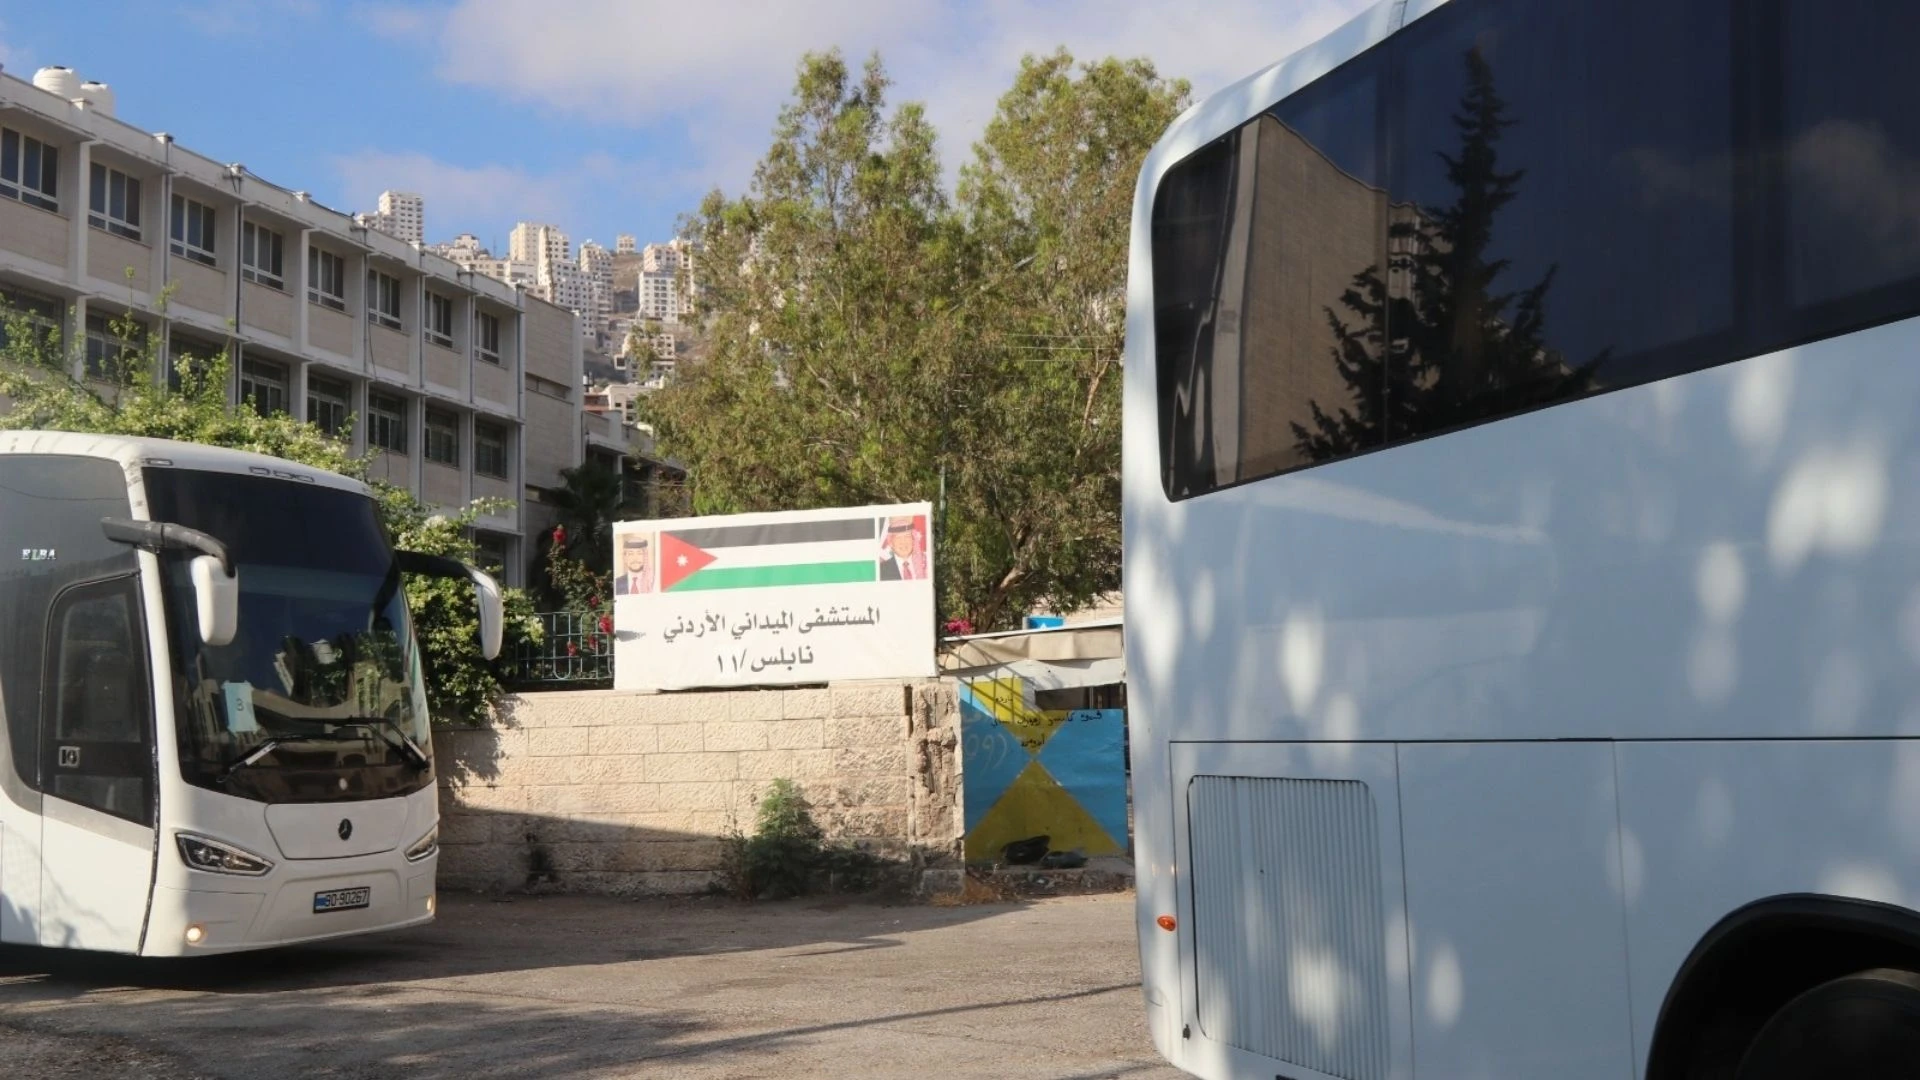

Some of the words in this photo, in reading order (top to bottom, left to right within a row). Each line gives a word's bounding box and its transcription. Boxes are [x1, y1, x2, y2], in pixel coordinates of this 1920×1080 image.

[21, 548, 57, 560] ELBA
[663, 608, 726, 643] الأردني
[730, 609, 794, 641] الميداني
[798, 605, 881, 634] المستشفى
[235, 697, 245, 712] 3
